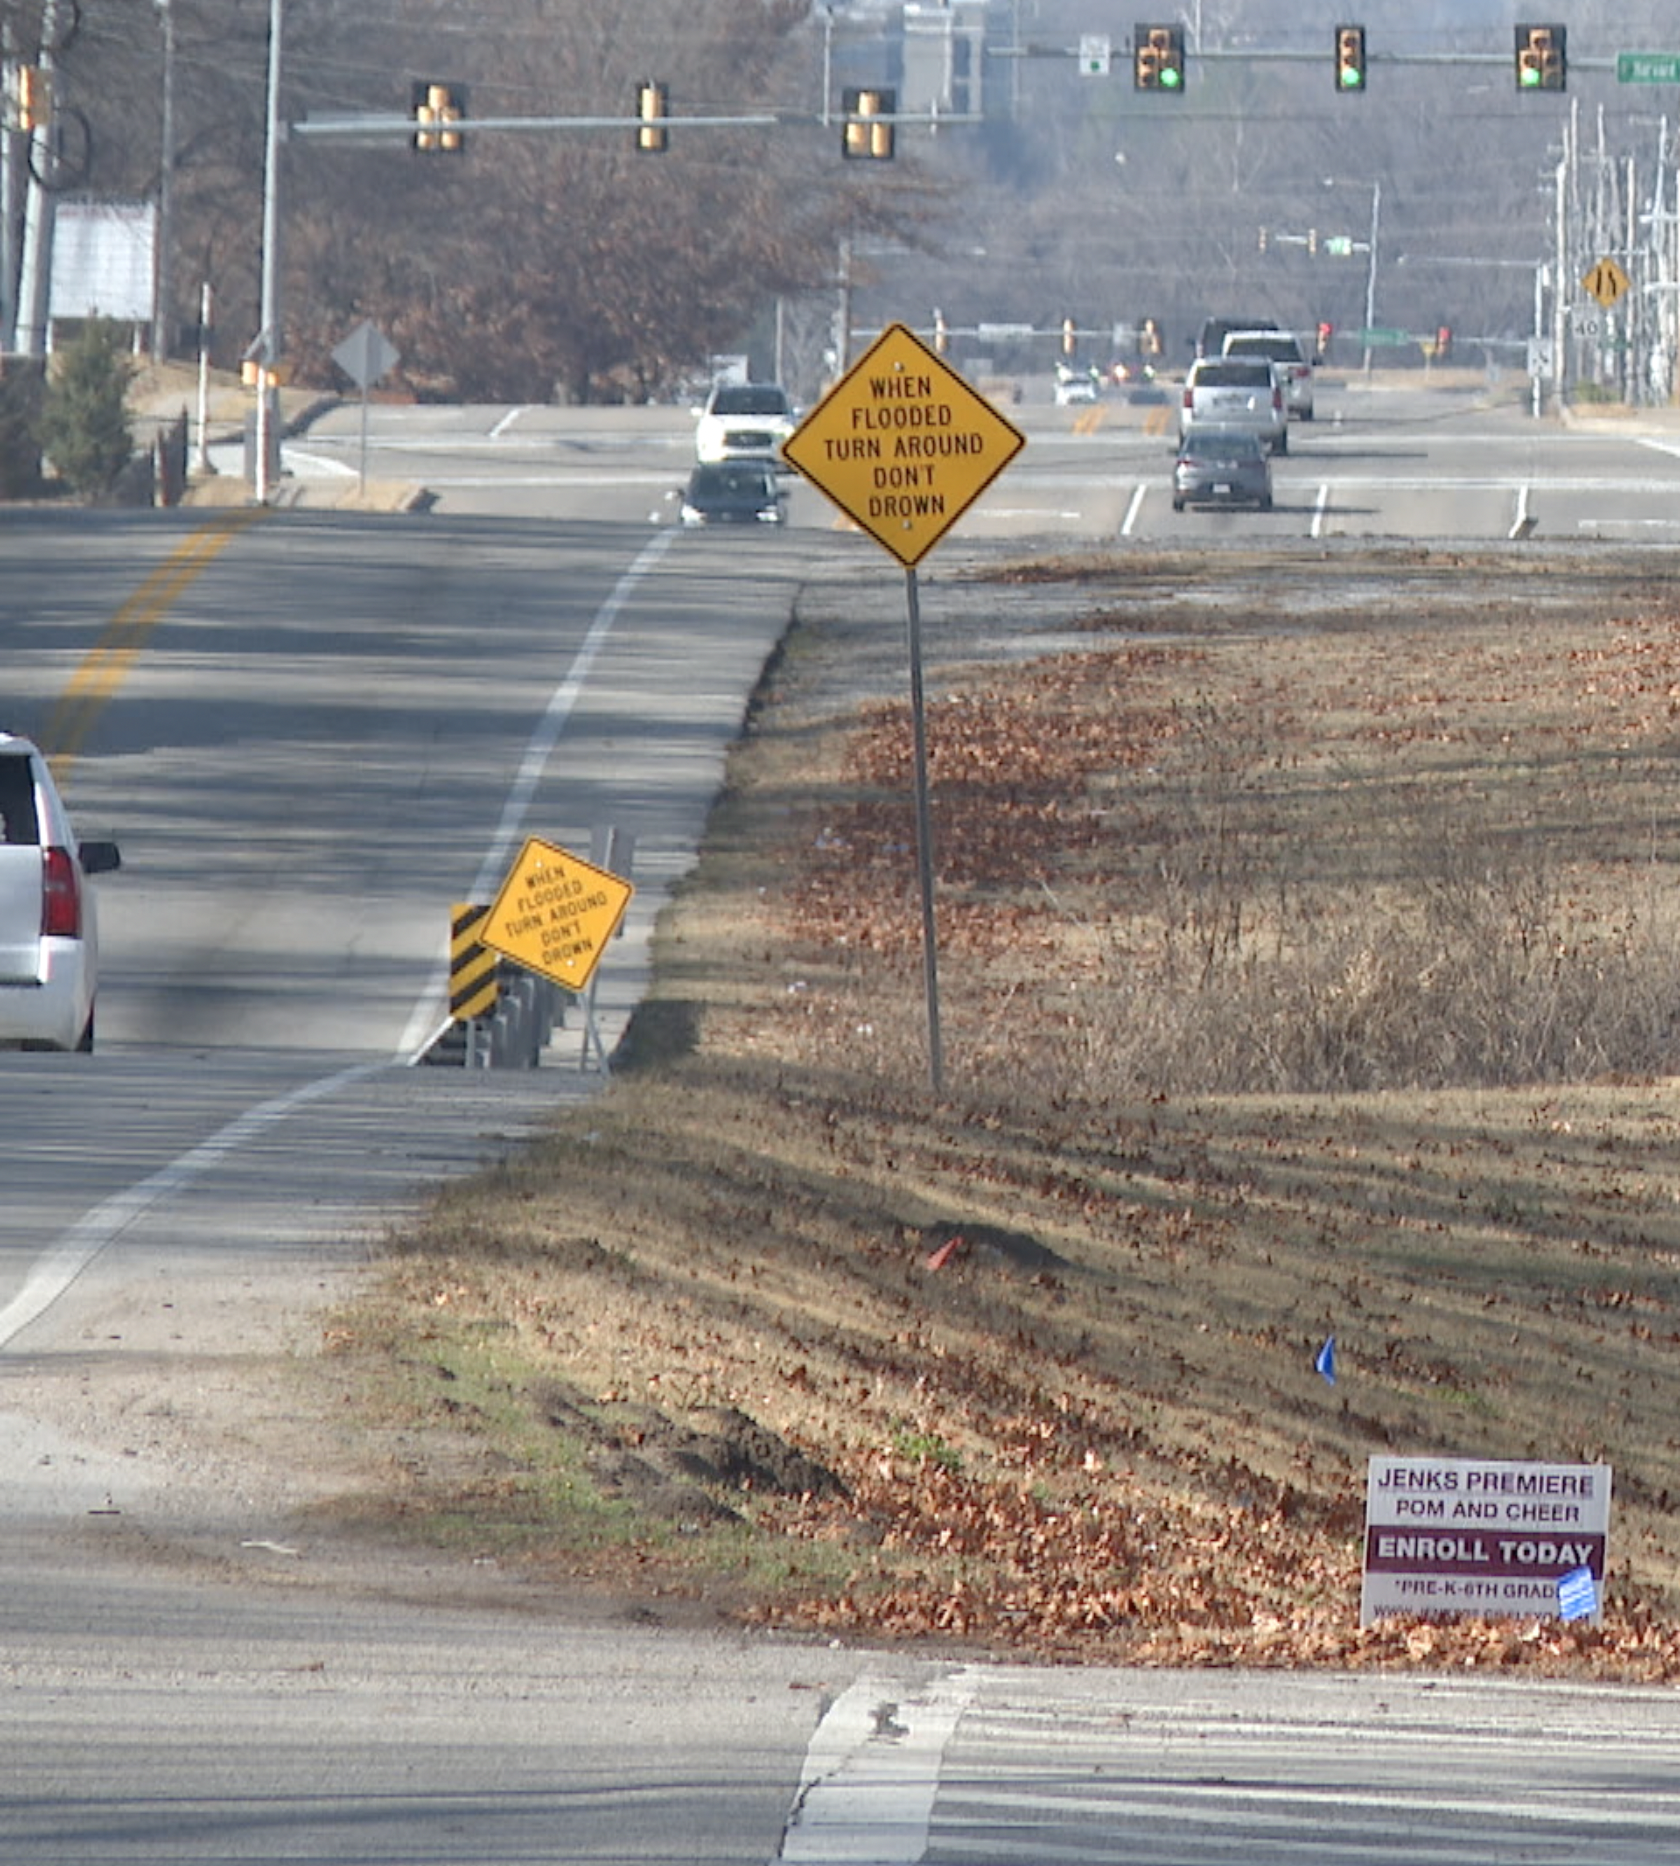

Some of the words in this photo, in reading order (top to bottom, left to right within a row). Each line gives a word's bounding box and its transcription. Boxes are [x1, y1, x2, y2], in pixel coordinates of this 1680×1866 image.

[869, 376, 931, 399] WHEN
[851, 405, 952, 430] FLOODED
[824, 437, 881, 461] TURN
[893, 432, 984, 458] AROUND
[873, 464, 935, 489] DON'T
[868, 495, 945, 518] DROWN
[526, 866, 565, 889] WHEN
[518, 879, 582, 912] FLOODED
[506, 914, 543, 938] TURN
[550, 891, 607, 921] AROUND
[541, 921, 581, 946] DON'T
[542, 938, 593, 964] DROWN
[1378, 1468, 1459, 1490] JENKS
[1466, 1471, 1594, 1497] PREMIERE
[1396, 1499, 1445, 1516] POM
[1452, 1500, 1498, 1518] AND
[1506, 1503, 1580, 1522] CHEER
[1378, 1536, 1489, 1562] ENROLL
[1499, 1541, 1594, 1565] TODAY
